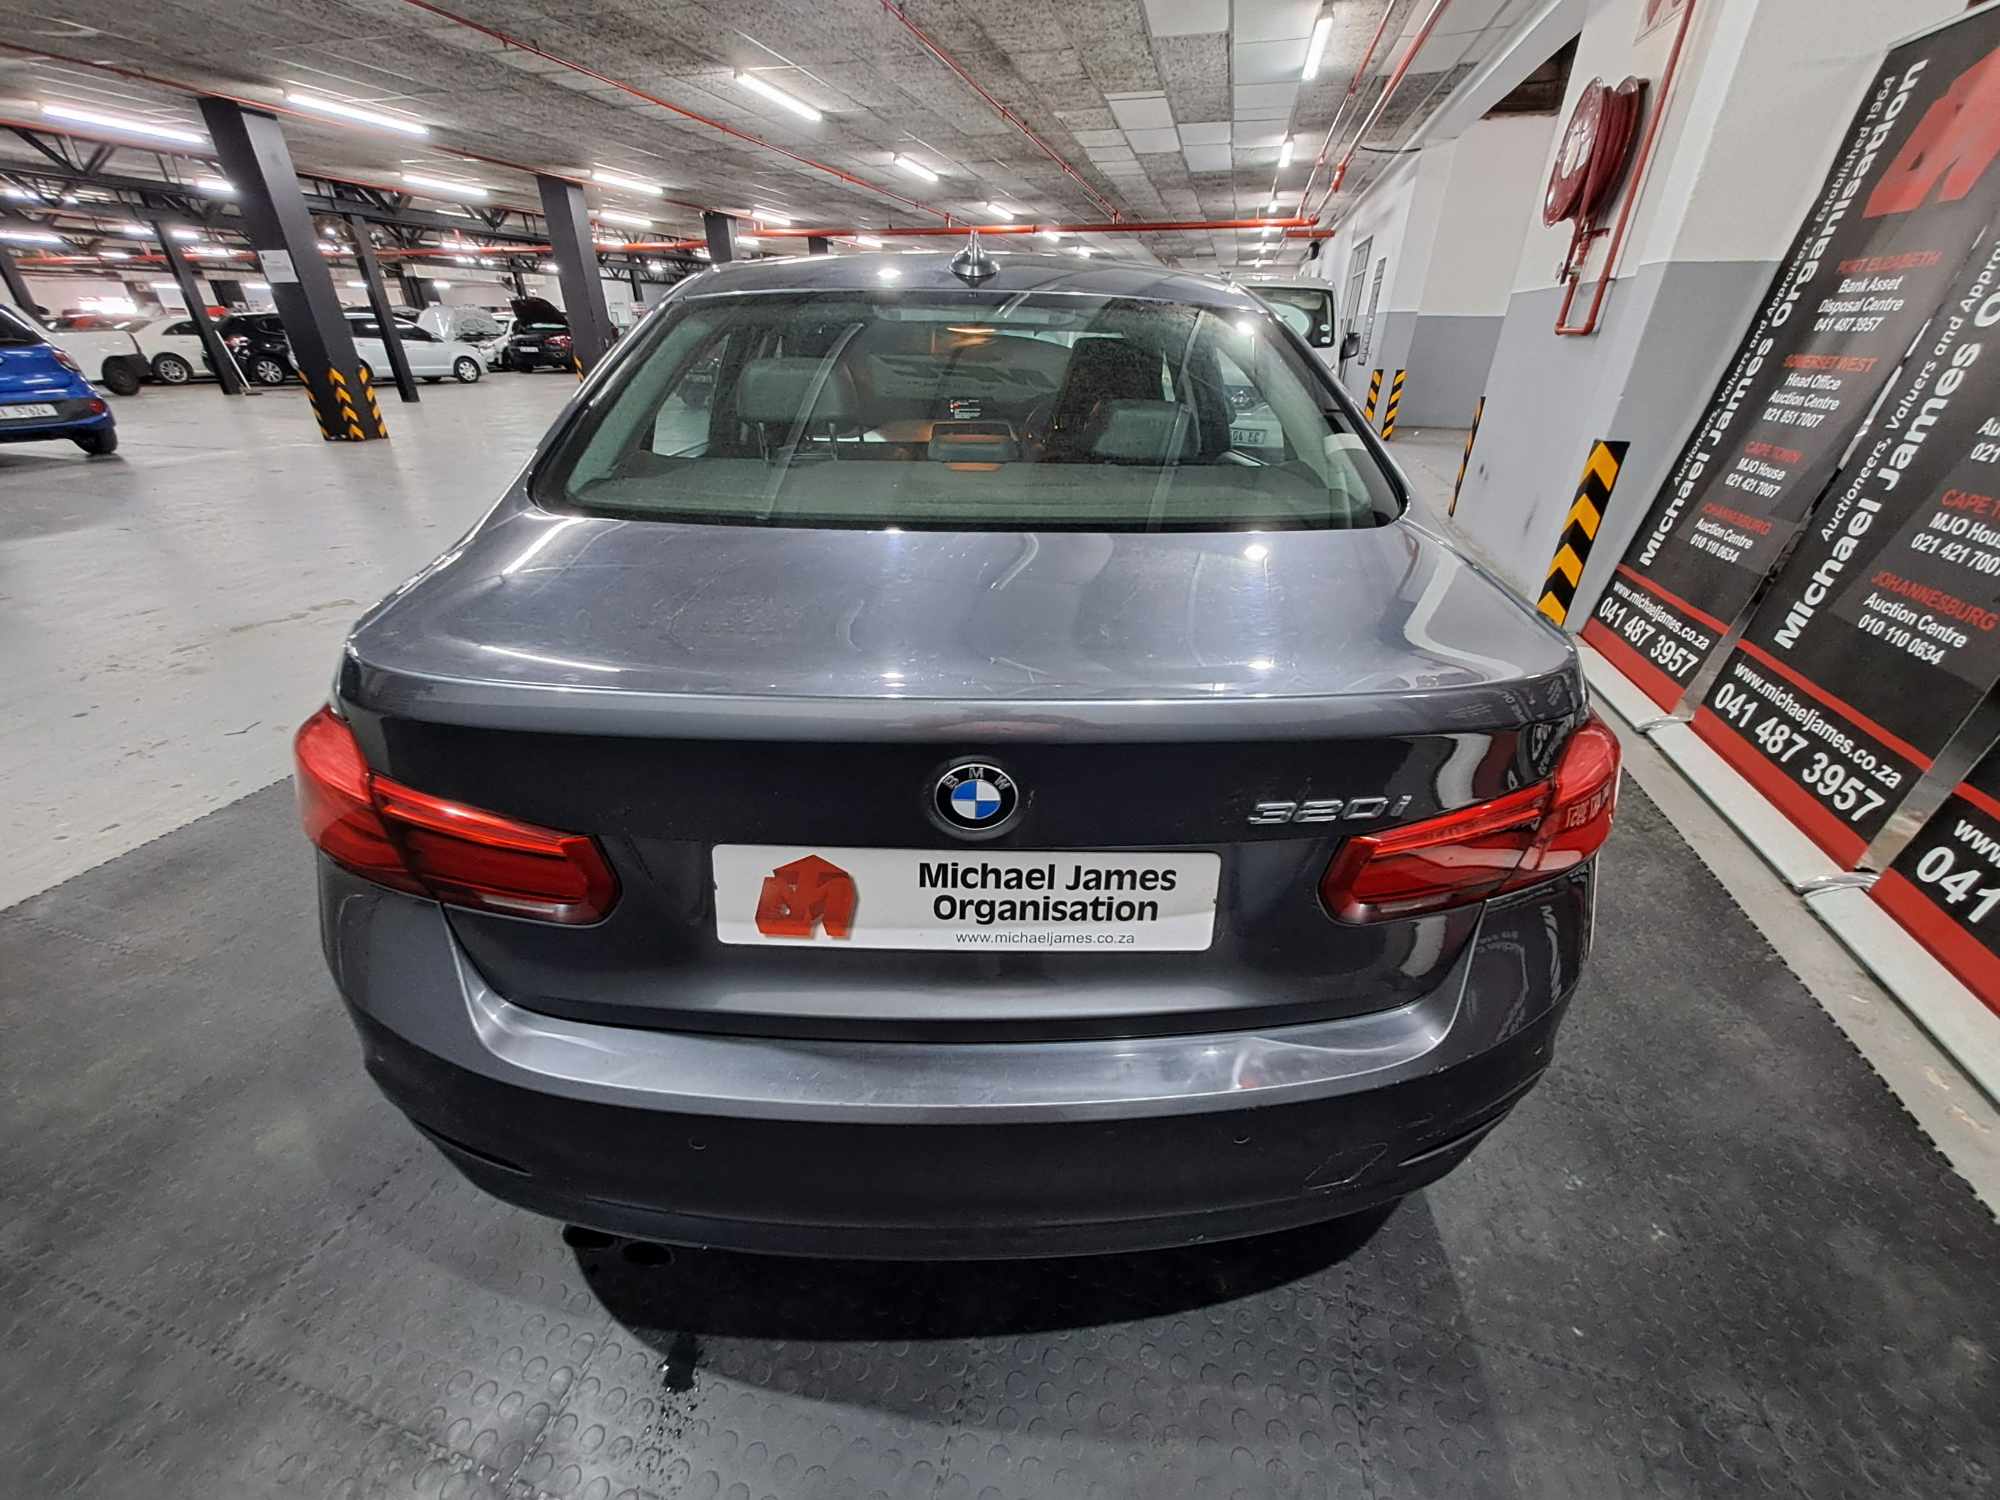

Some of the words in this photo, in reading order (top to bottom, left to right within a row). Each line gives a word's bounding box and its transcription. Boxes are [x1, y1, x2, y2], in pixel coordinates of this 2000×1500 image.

[1674, 408, 1721, 486] Auctioneers,
[1718, 352, 1750, 403] Valuers
[1750, 320, 1768, 349] and
[1767, 237, 1813, 318] Appraisers
[1816, 127, 1871, 222] Established
[1866, 76, 1896, 122] 1964
[1838, 278, 1869, 293] Bank
[1867, 275, 1904, 292] Asset
[1639, 452, 1711, 567] Michael
[1709, 338, 1774, 446] James
[1772, 58, 1929, 327] Organisation
[1818, 297, 1865, 315] Disposal
[1863, 297, 1905, 311] Centre
[1813, 317, 1836, 332] 041
[1784, 372, 1815, 388] Head
[1811, 374, 1842, 391] Office
[1768, 390, 1805, 407] Auction
[1803, 393, 1841, 411] Centre
[1796, 412, 1826, 429] 7007
[1820, 437, 1893, 542] Auctioneers,
[1885, 360, 1937, 431] Valuers
[1934, 316, 1964, 356] and
[1970, 442, 2000, 464] 021
[1736, 457, 1760, 474] MJO
[1756, 462, 1786, 481] House
[1754, 481, 1782, 498] 7007
[1773, 498, 1883, 650] Michael
[1877, 343, 1982, 491] James
[1941, 488, 1993, 514] CAPE
[1694, 517, 1725, 538] Auction
[1723, 528, 1754, 549] Centre
[1929, 511, 1970, 536] MJO
[1689, 533, 1707, 548] 010
[1705, 539, 1720, 555] 110
[1715, 545, 1740, 563] 0634
[1911, 532, 1942, 554] 021
[1939, 541, 1971, 564] 421
[1613, 580, 1710, 651] www.michaeljames.co.za
[1871, 570, 1999, 632] JOHANNESBURG
[1863, 592, 1916, 626] Auction
[1917, 614, 1968, 649] Centre
[1599, 596, 1628, 628] 041
[1623, 615, 1657, 647] 487
[1650, 634, 1700, 678] 3957
[1857, 613, 1885, 636] 010
[1884, 625, 1911, 649] 110
[1906, 637, 1946, 665] 0634
[1733, 661, 1903, 790] www.michaeljames.co.za
[1713, 682, 1759, 728] 041
[1754, 716, 1810, 763] 487
[1801, 752, 1887, 823] 3957
[942, 767, 1011, 790] BMW
[1247, 795, 1412, 825] 320i
[918, 862, 1056, 890] Michael
[1065, 864, 1177, 891] James
[1916, 846, 2000, 924] 041
[933, 894, 1159, 925] Organisation
[956, 931, 1135, 946] www.michaeljames.co.za
